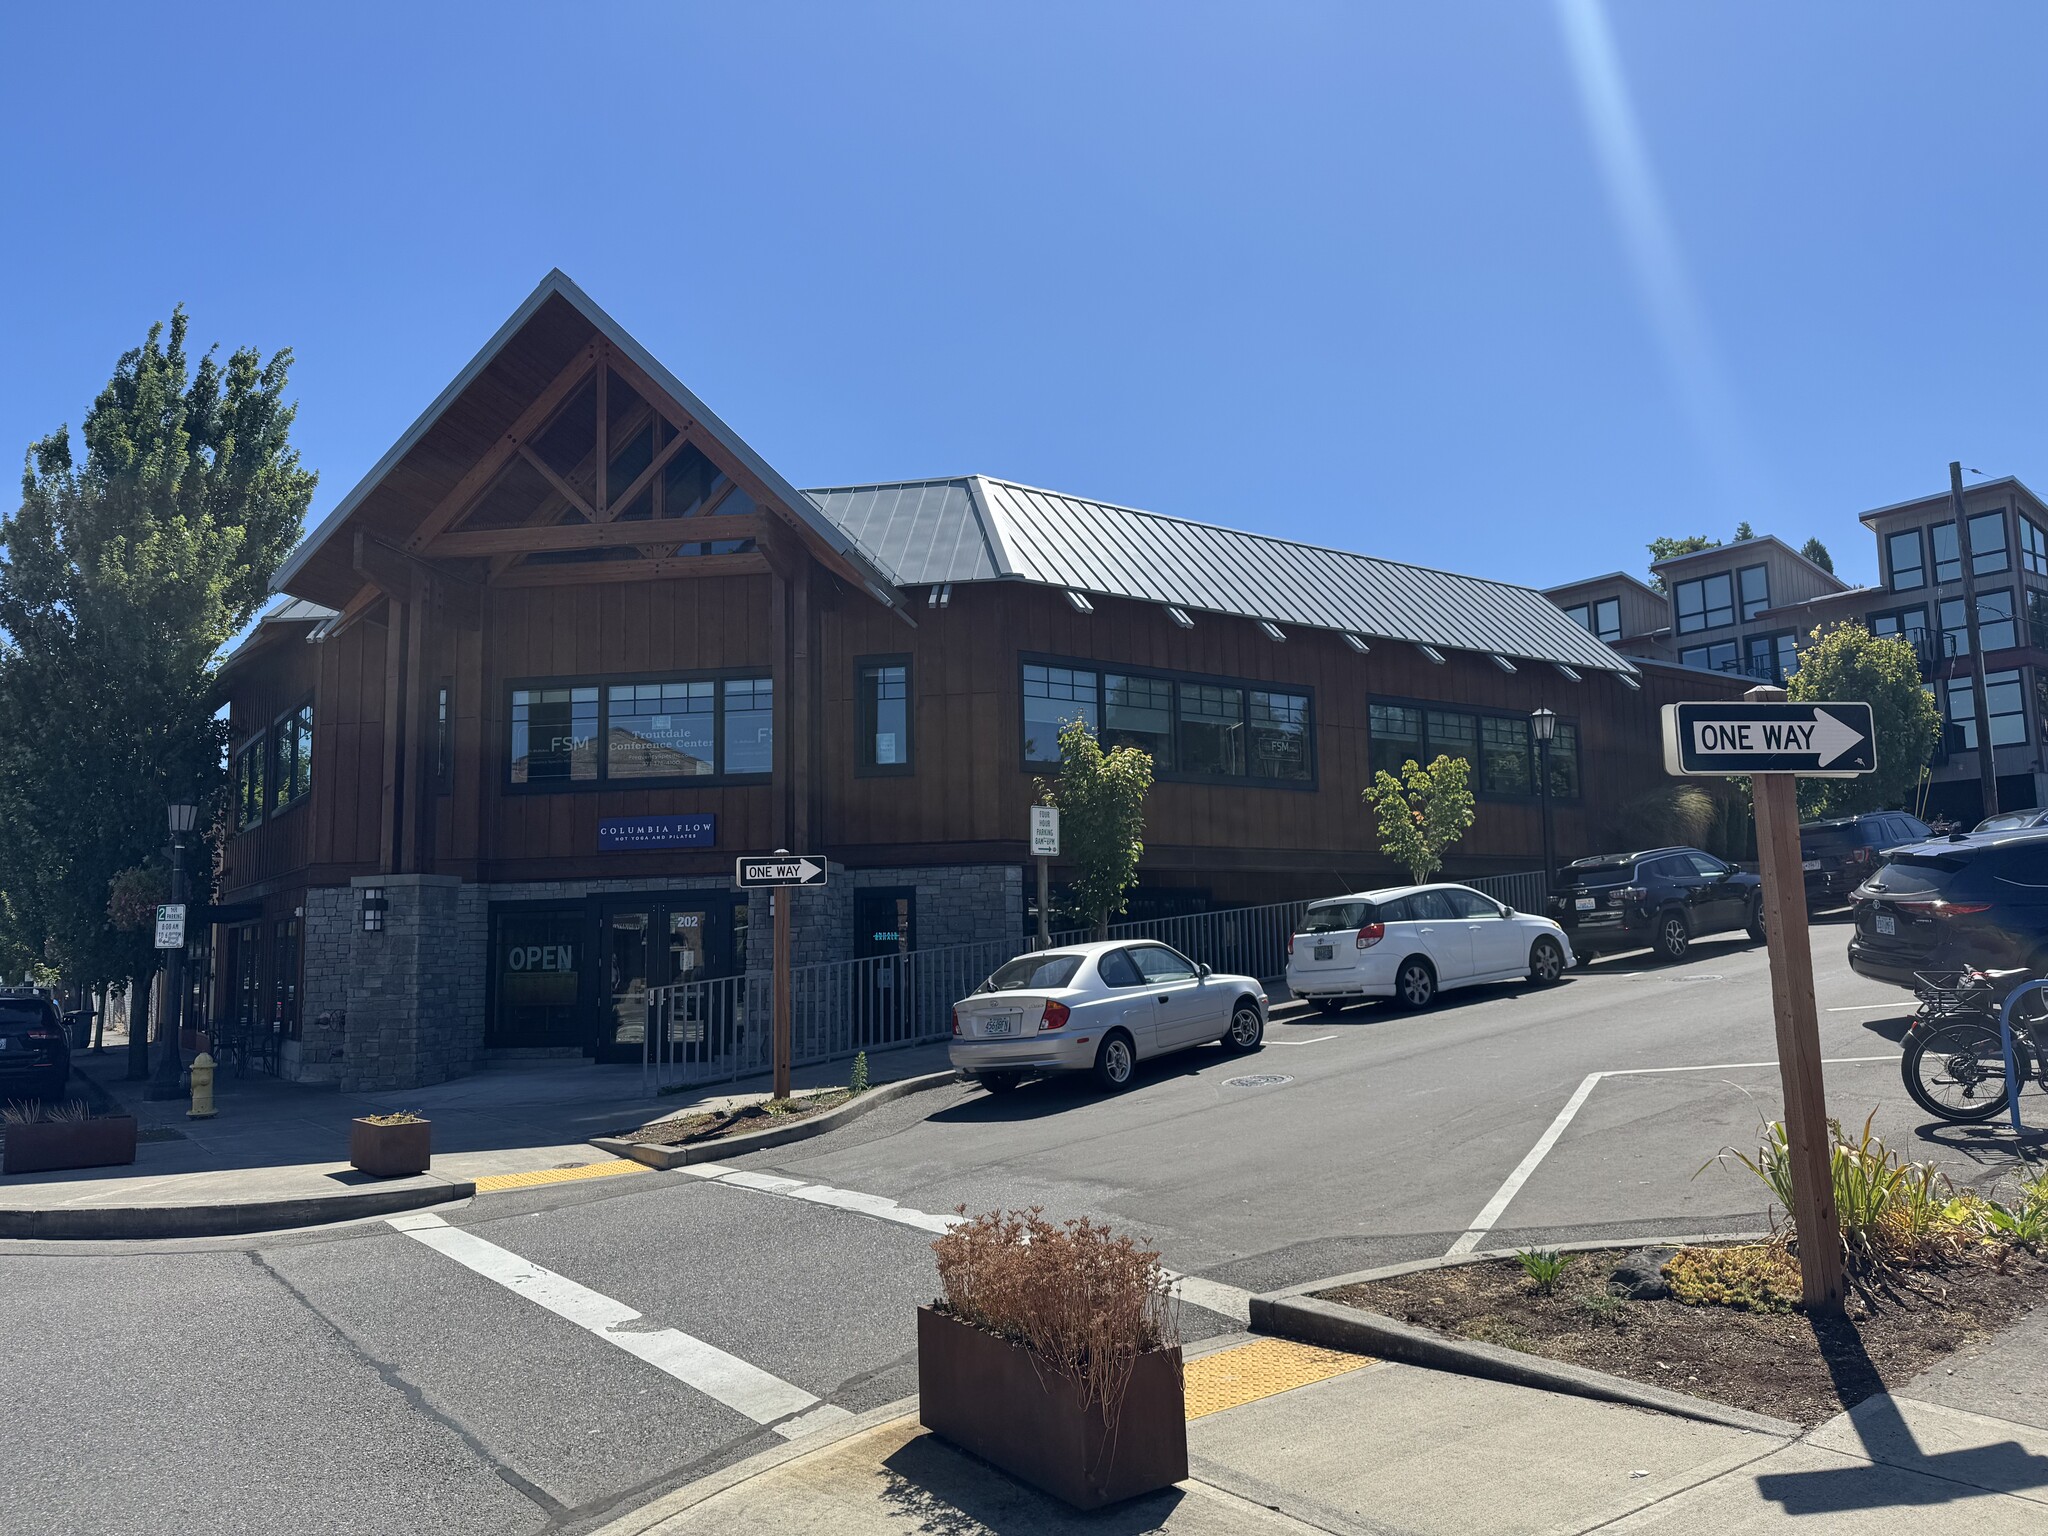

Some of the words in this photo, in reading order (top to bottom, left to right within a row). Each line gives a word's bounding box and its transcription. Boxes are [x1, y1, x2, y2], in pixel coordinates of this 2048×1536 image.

[632, 729, 691, 740] Troutdale
[1702, 725, 1753, 750] ONE
[1762, 725, 1815, 750] WAY
[552, 736, 589, 752] FSM
[609, 741, 673, 751] Conference
[676, 739, 714, 748] Center
[1272, 741, 1289, 752] FSM
[1039, 819, 1051, 827] HOUR
[600, 826, 669, 835] COLUMBIA
[677, 824, 711, 832] FLOW
[749, 866, 772, 878] ONE
[776, 865, 801, 877] WAY
[158, 908, 165, 920] 2
[677, 916, 698, 928] 202
[509, 945, 572, 970] OPEN
